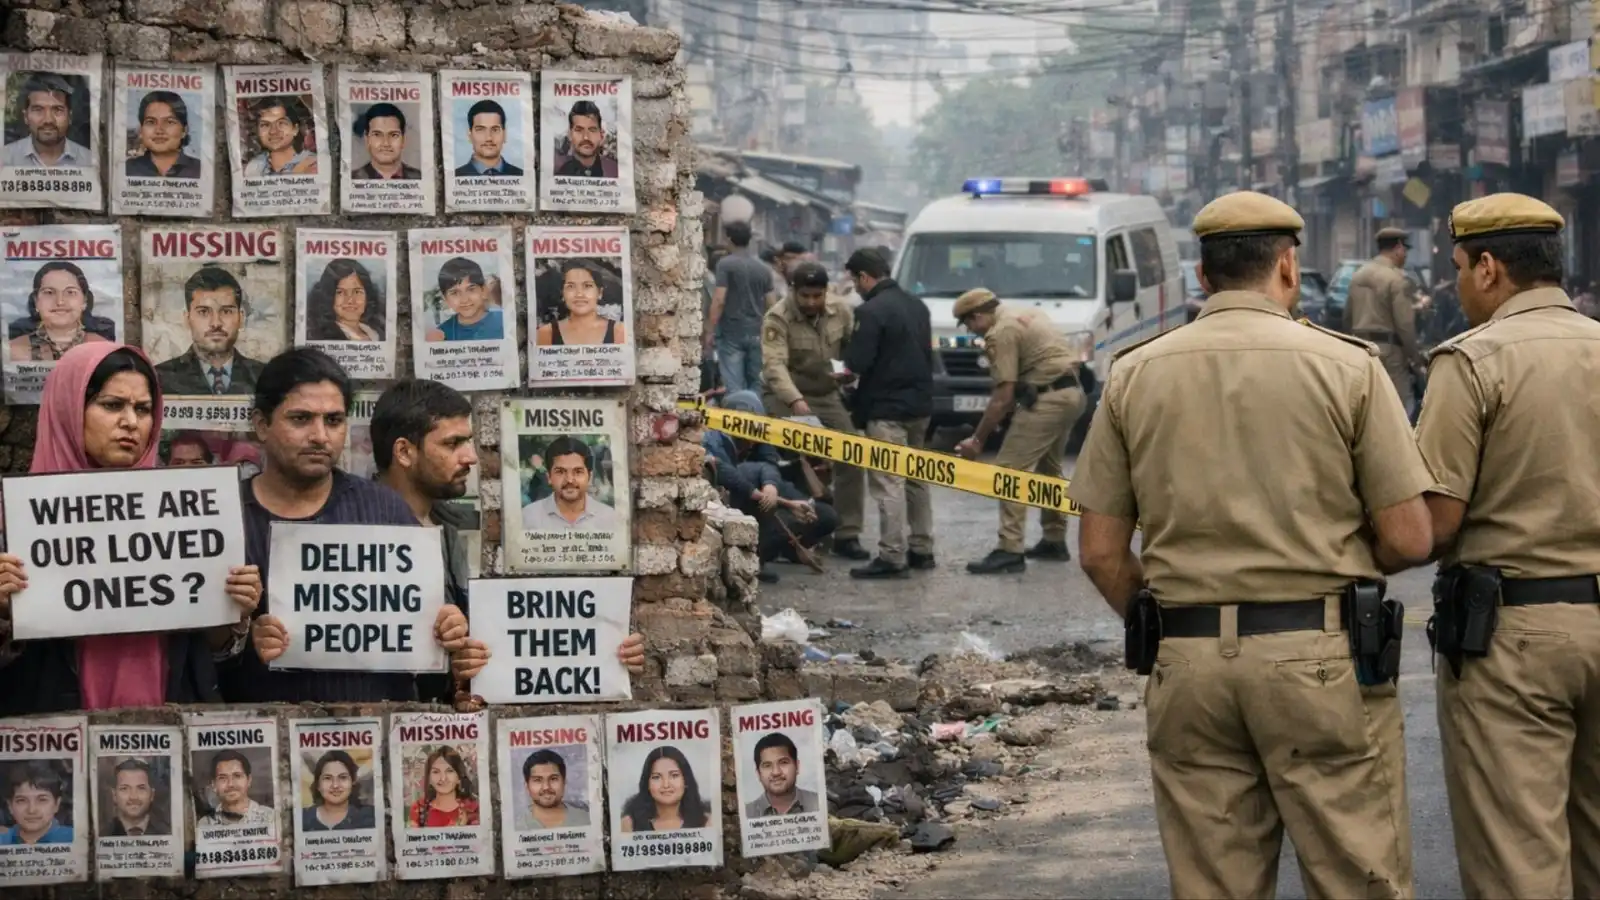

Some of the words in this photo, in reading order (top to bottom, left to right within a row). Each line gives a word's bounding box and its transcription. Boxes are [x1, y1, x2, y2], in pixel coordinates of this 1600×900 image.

[127, 73, 203, 90] MISSING
[236, 77, 312, 94] MISSING
[452, 81, 520, 97] MISSING
[554, 82, 618, 97] MISSING
[349, 86, 420, 101] MISSING
[7, 239, 114, 257] MISSING
[152, 231, 277, 258] MISSING
[306, 240, 387, 256] MISSING
[421, 238, 498, 255] MISSING
[532, 238, 622, 254] MISSING
[525, 408, 604, 428] MISSING
[722, 414, 771, 441] CRIME
[782, 428, 833, 457] SCENE
[842, 440, 863, 464] DO
[869, 446, 900, 472] NOT
[906, 453, 956, 485] CROSS
[993, 472, 1020, 499] CRE
[29, 492, 146, 525] WHERE
[157, 488, 220, 519] ARE
[30, 536, 97, 568] OUR
[108, 528, 225, 563] LOVED
[301, 543, 413, 573] DELHI'S
[293, 583, 422, 613] MISSING
[507, 590, 596, 619] BRING
[304, 624, 413, 653] PEOPLE
[507, 628, 597, 657] THEM
[515, 666, 601, 696] BACK!
[739, 709, 814, 732] MISSING
[198, 728, 264, 747] MISSING
[299, 730, 373, 748] MISSING
[400, 723, 479, 742] MISSING
[509, 728, 587, 746] MISSING
[617, 719, 709, 743] MISSING
[100, 733, 171, 750] MISSING
